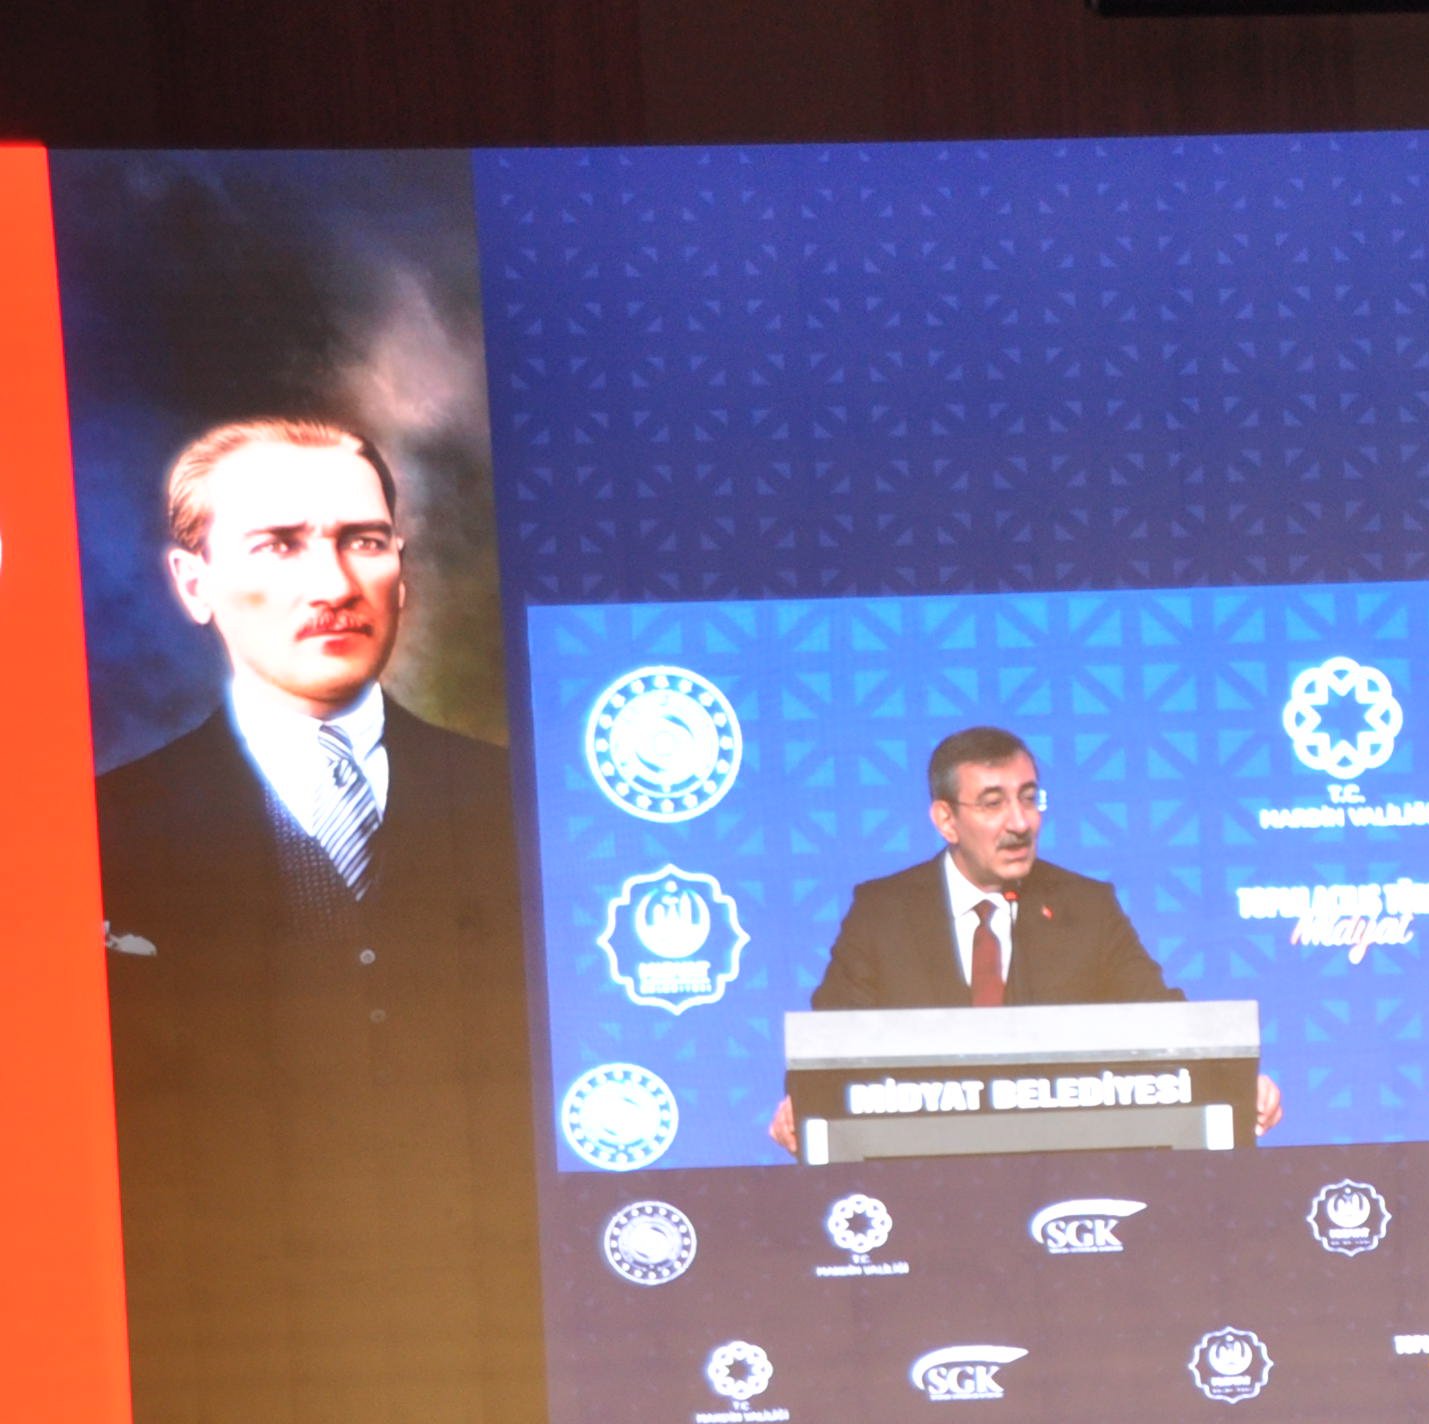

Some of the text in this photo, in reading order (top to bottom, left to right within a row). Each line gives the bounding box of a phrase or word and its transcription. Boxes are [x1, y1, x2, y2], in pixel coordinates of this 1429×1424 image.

[849, 1068, 1192, 1115] MİDYAT BELEDİYESİ
[1046, 1218, 1124, 1250] SGK
[928, 1364, 1005, 1395] SGK
